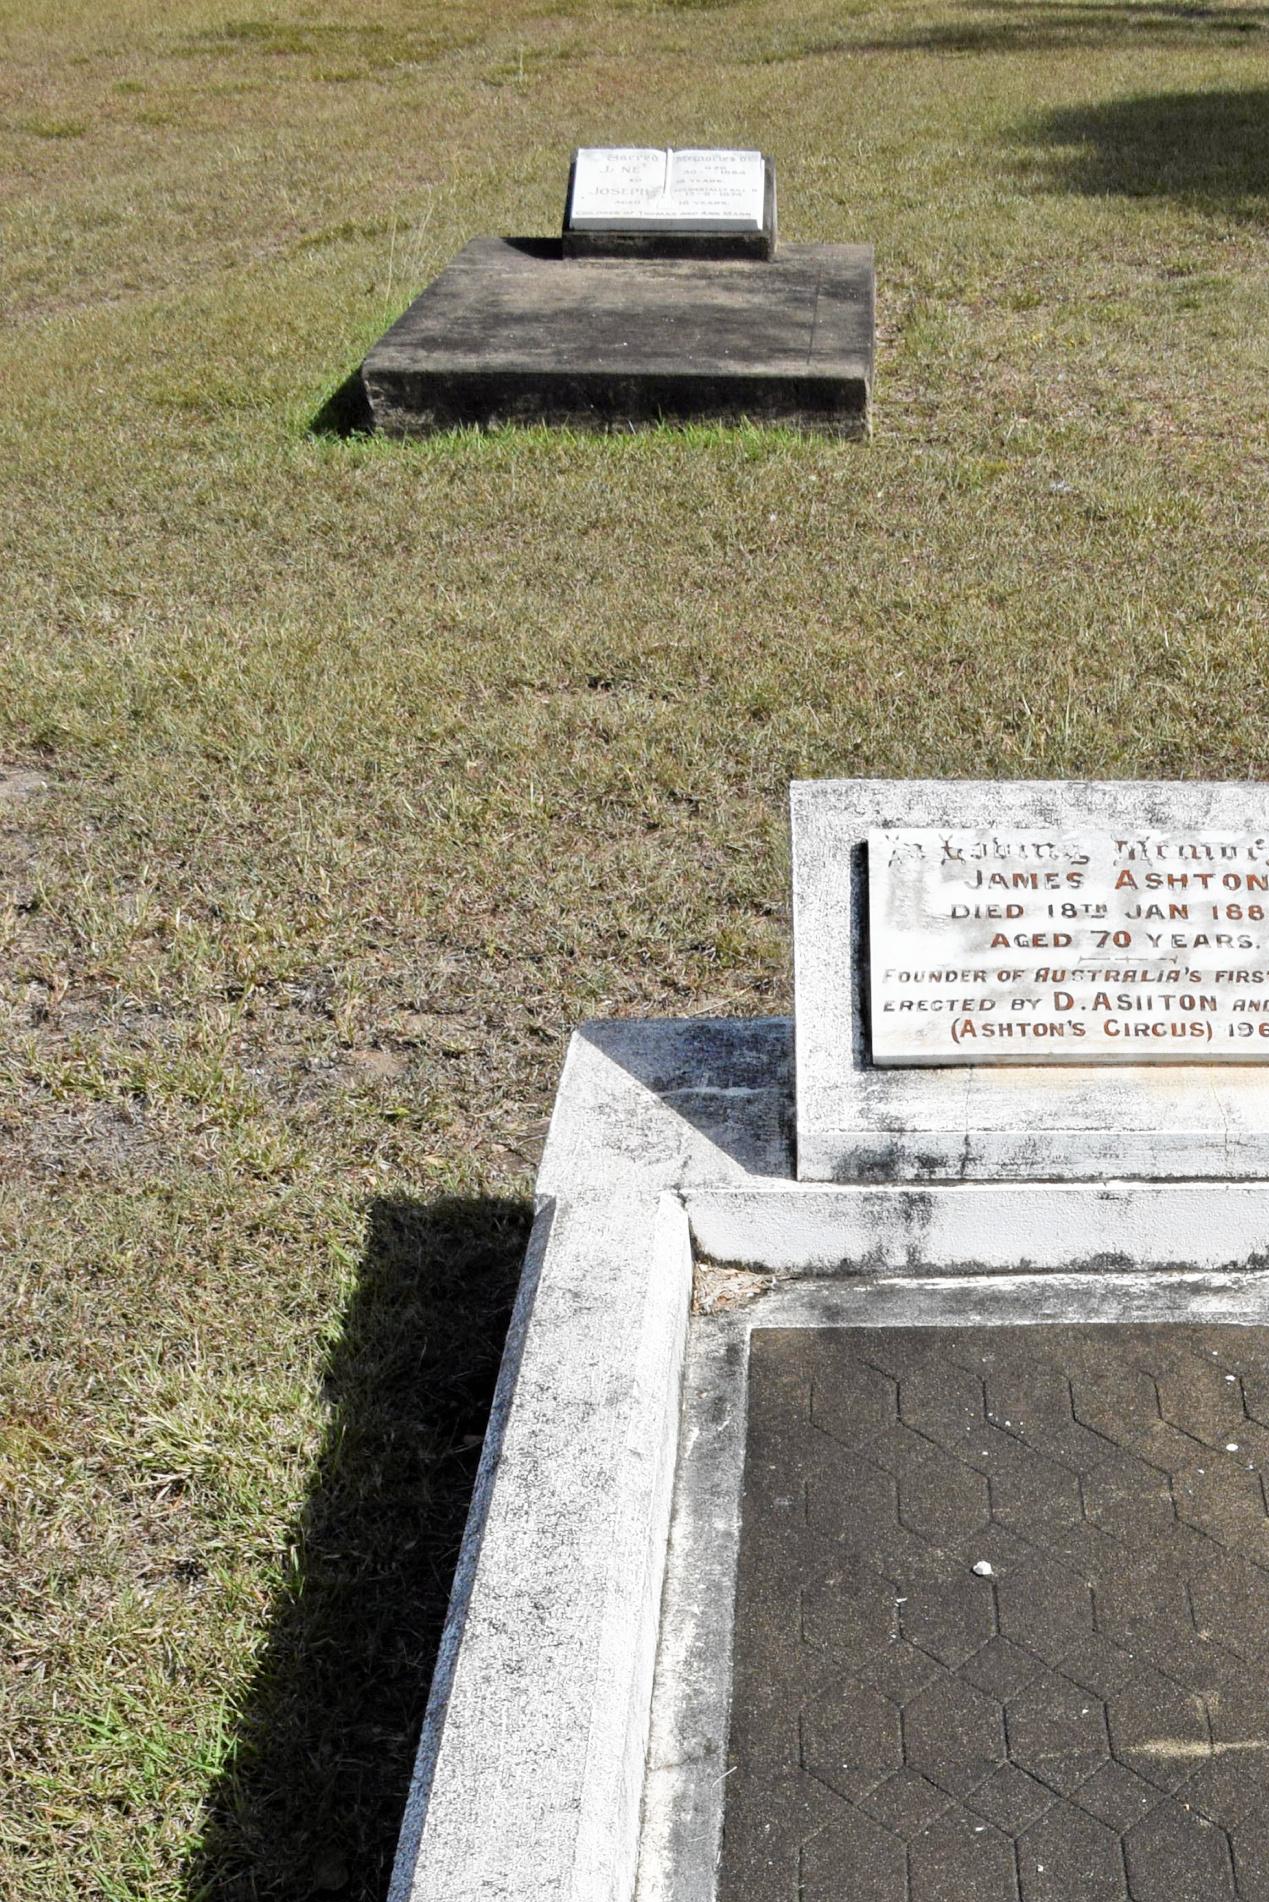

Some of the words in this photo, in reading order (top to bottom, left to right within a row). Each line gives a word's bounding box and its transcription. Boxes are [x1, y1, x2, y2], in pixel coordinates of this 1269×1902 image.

[964, 869, 1085, 890] JAMES
[951, 903, 1024, 919] DIED
[1124, 904, 1189, 920] JAN
[990, 931, 1072, 949] AGED
[1090, 929, 1132, 949] 70
[1146, 932, 1261, 949] YEARS.
[882, 968, 987, 984] FOUNDER
[996, 969, 1025, 984] OF
[1034, 966, 1202, 984] AUSTRALIA'S
[883, 998, 997, 1012] ERECTED
[1011, 997, 1044, 1011] BY
[951, 1017, 1087, 1044] (ASHTON'S
[1104, 1018, 1213, 1043] CIRCUS)
